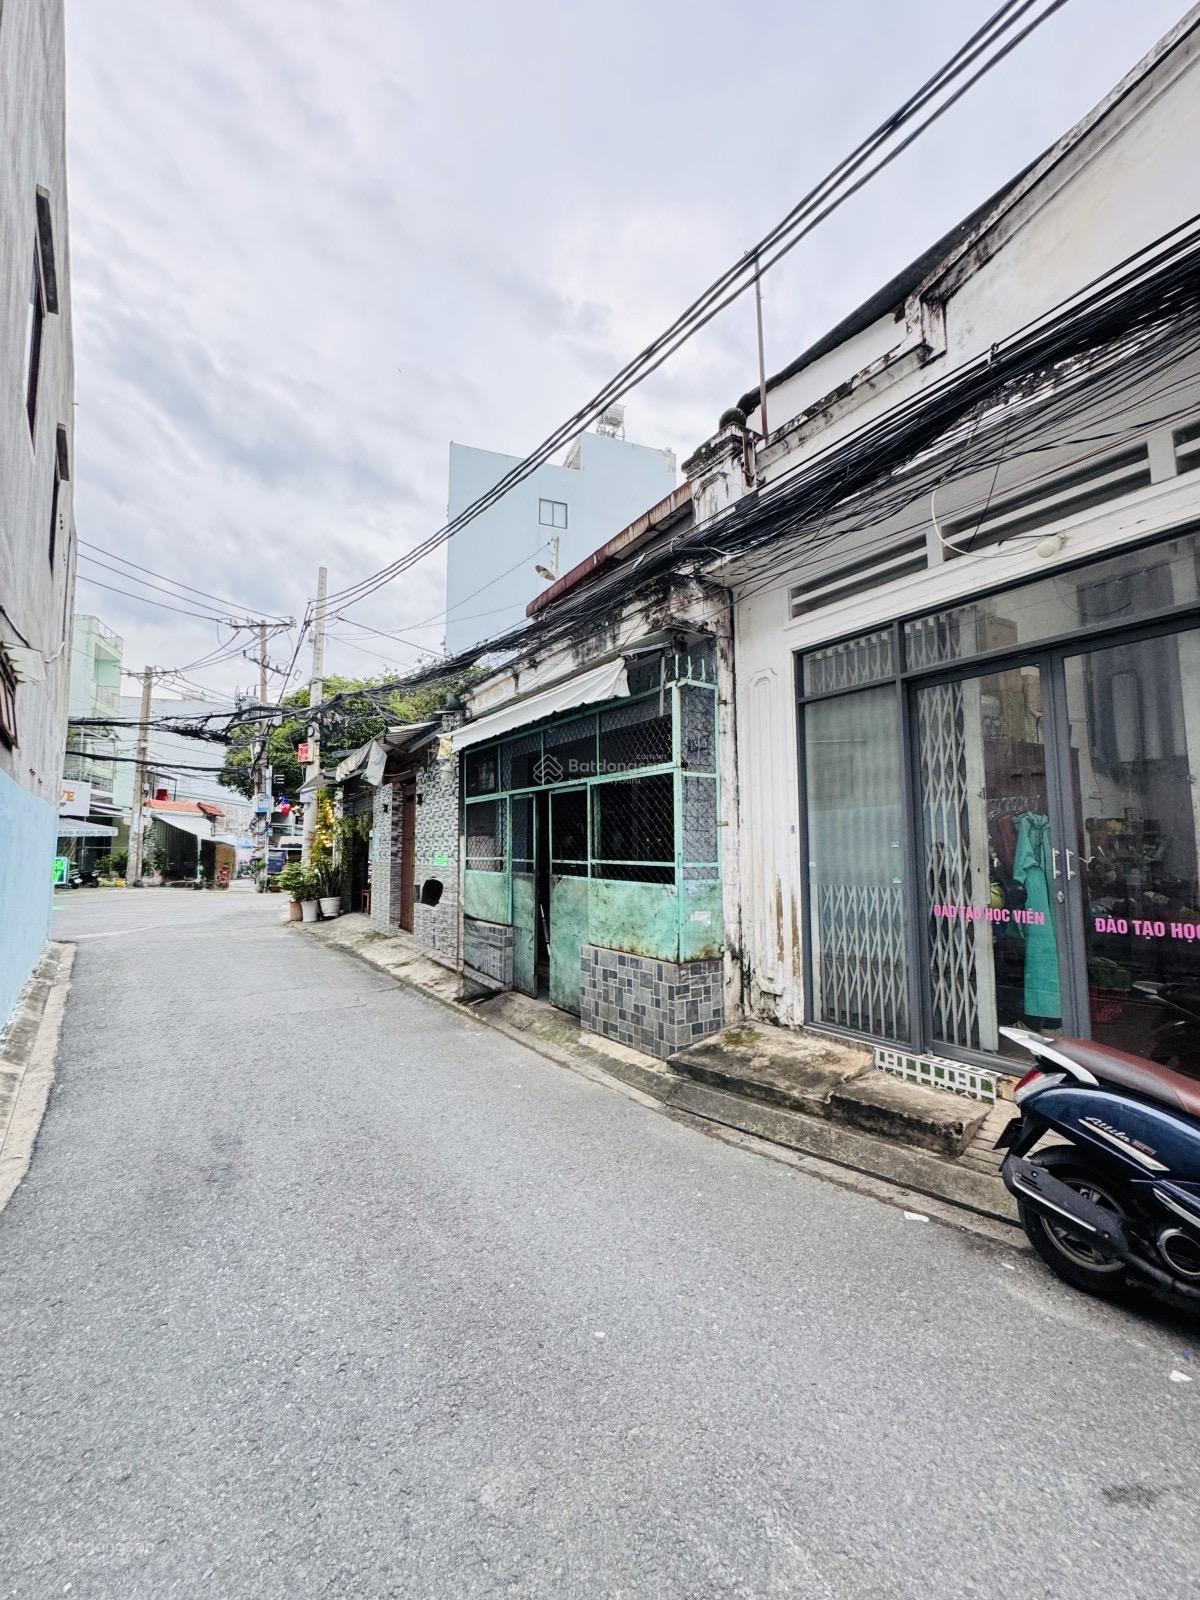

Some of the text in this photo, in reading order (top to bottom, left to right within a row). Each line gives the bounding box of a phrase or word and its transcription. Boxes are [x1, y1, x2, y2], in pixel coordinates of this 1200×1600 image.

[933, 902, 1045, 925] ĐÀO TẠO HỌC VIÊN
[1095, 914, 1128, 935] ĐÀO
[1132, 920, 1166, 940] TẠO
